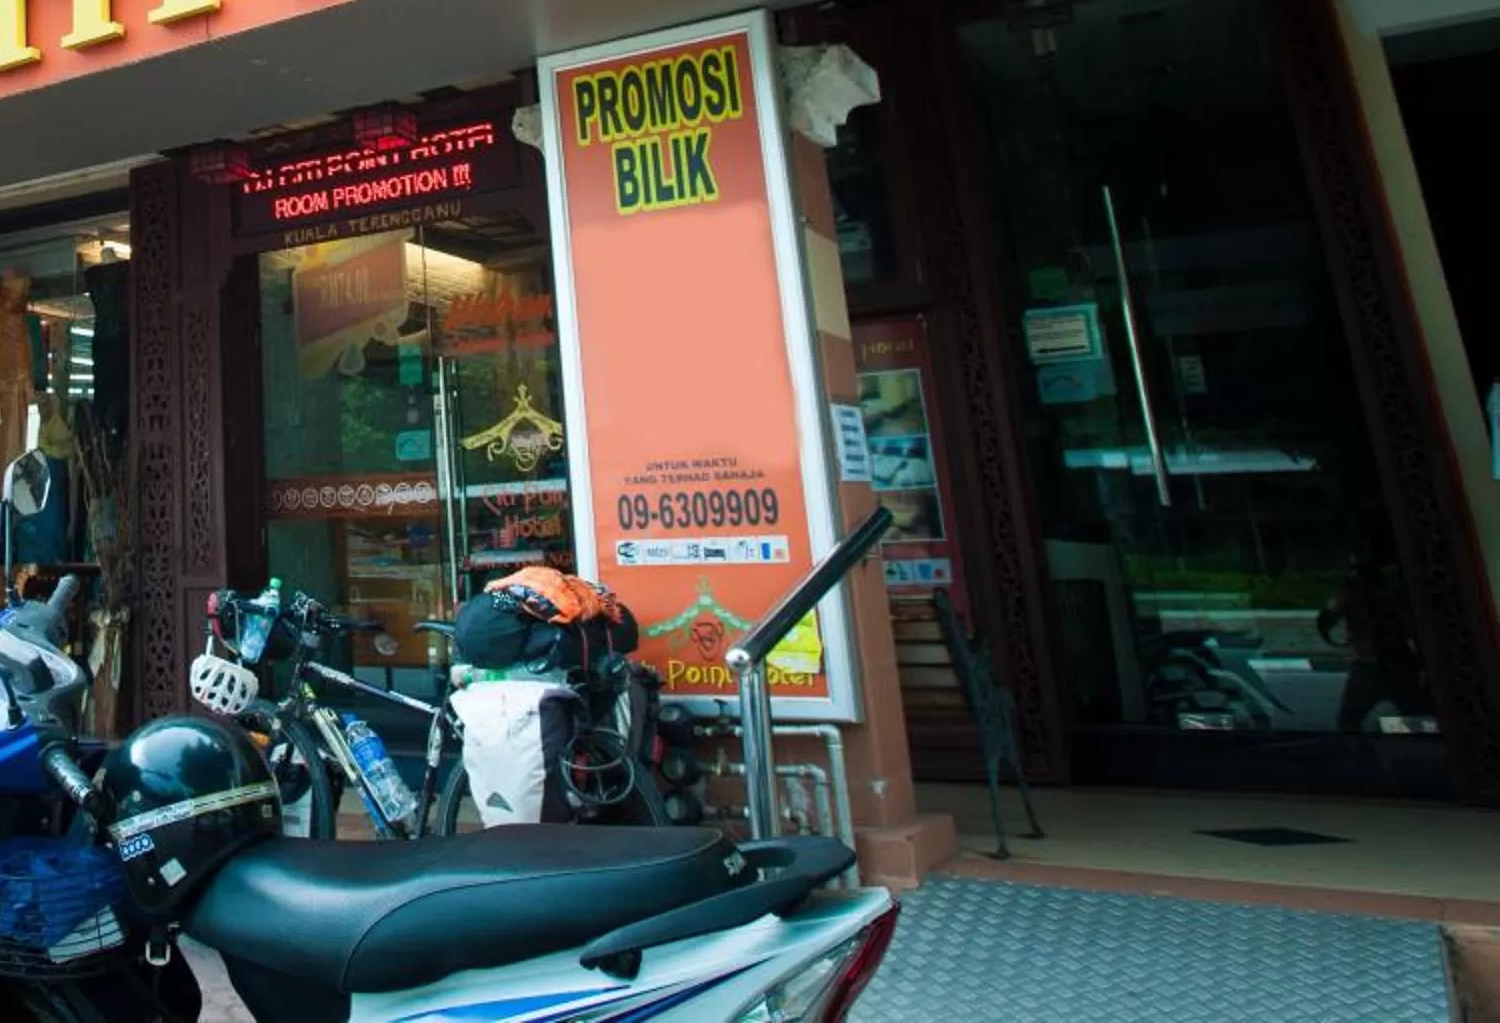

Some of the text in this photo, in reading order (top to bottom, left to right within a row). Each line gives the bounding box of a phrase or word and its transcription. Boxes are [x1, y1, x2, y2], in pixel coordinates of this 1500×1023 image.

[573, 46, 743, 146] PROMOSI
[275, 190, 329, 219] ROOM
[332, 168, 449, 208] PROMOTION
[612, 128, 719, 215] BILIK
[284, 199, 463, 247] KUALA TERENGGANU
[617, 488, 780, 530] 09-6309909
